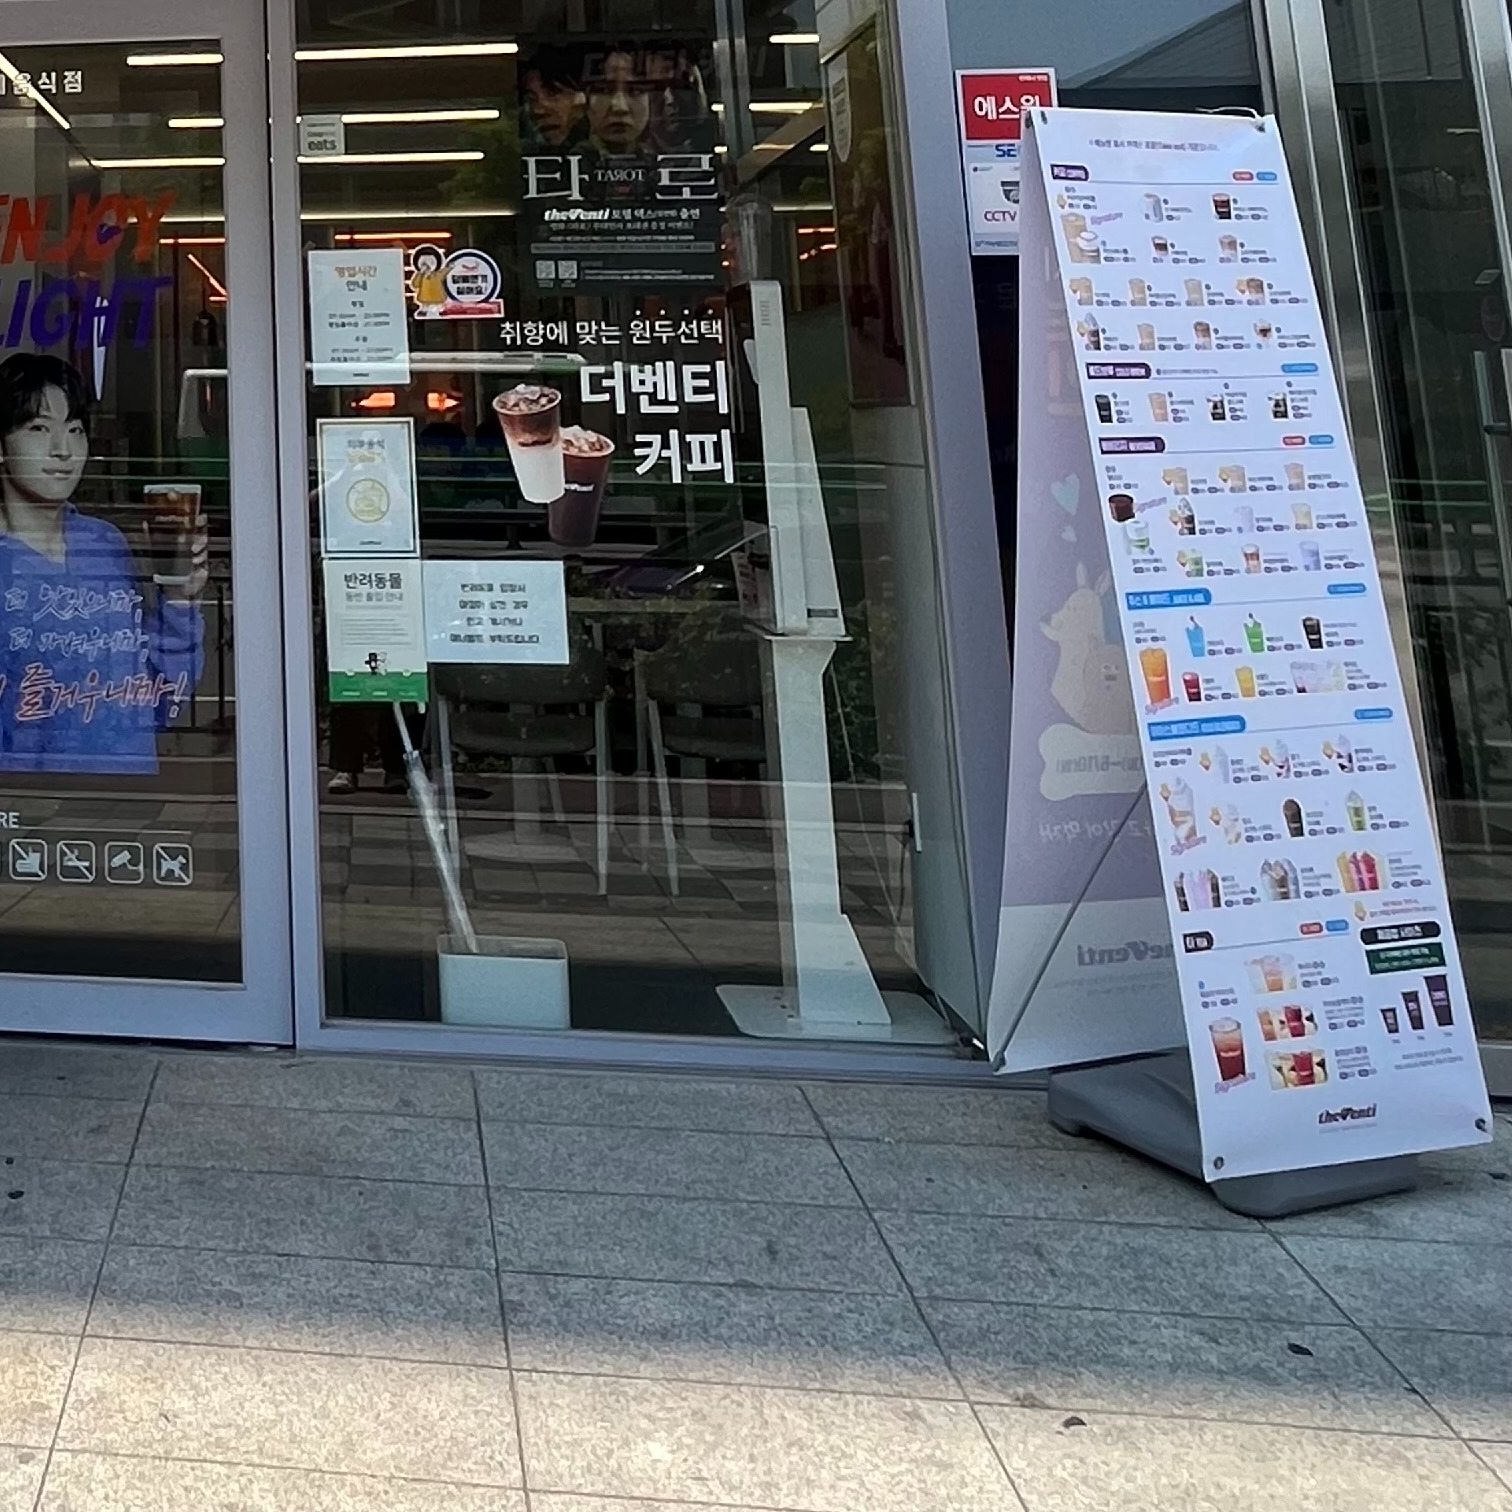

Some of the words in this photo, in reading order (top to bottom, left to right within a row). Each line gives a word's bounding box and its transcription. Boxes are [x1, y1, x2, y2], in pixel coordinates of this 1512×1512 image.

[983, 210, 1018, 222] CCTV
[499, 320, 569, 346] 취향에
[575, 320, 622, 346] 맞는
[628, 318, 724, 345] 원두선택
[579, 360, 730, 415] 더벤티
[633, 429, 735, 484] 커피
[343, 572, 403, 590] 반려동물
[15, 662, 189, 724] 즐거우니까!
[1318, 1103, 1377, 1126] theVenti
